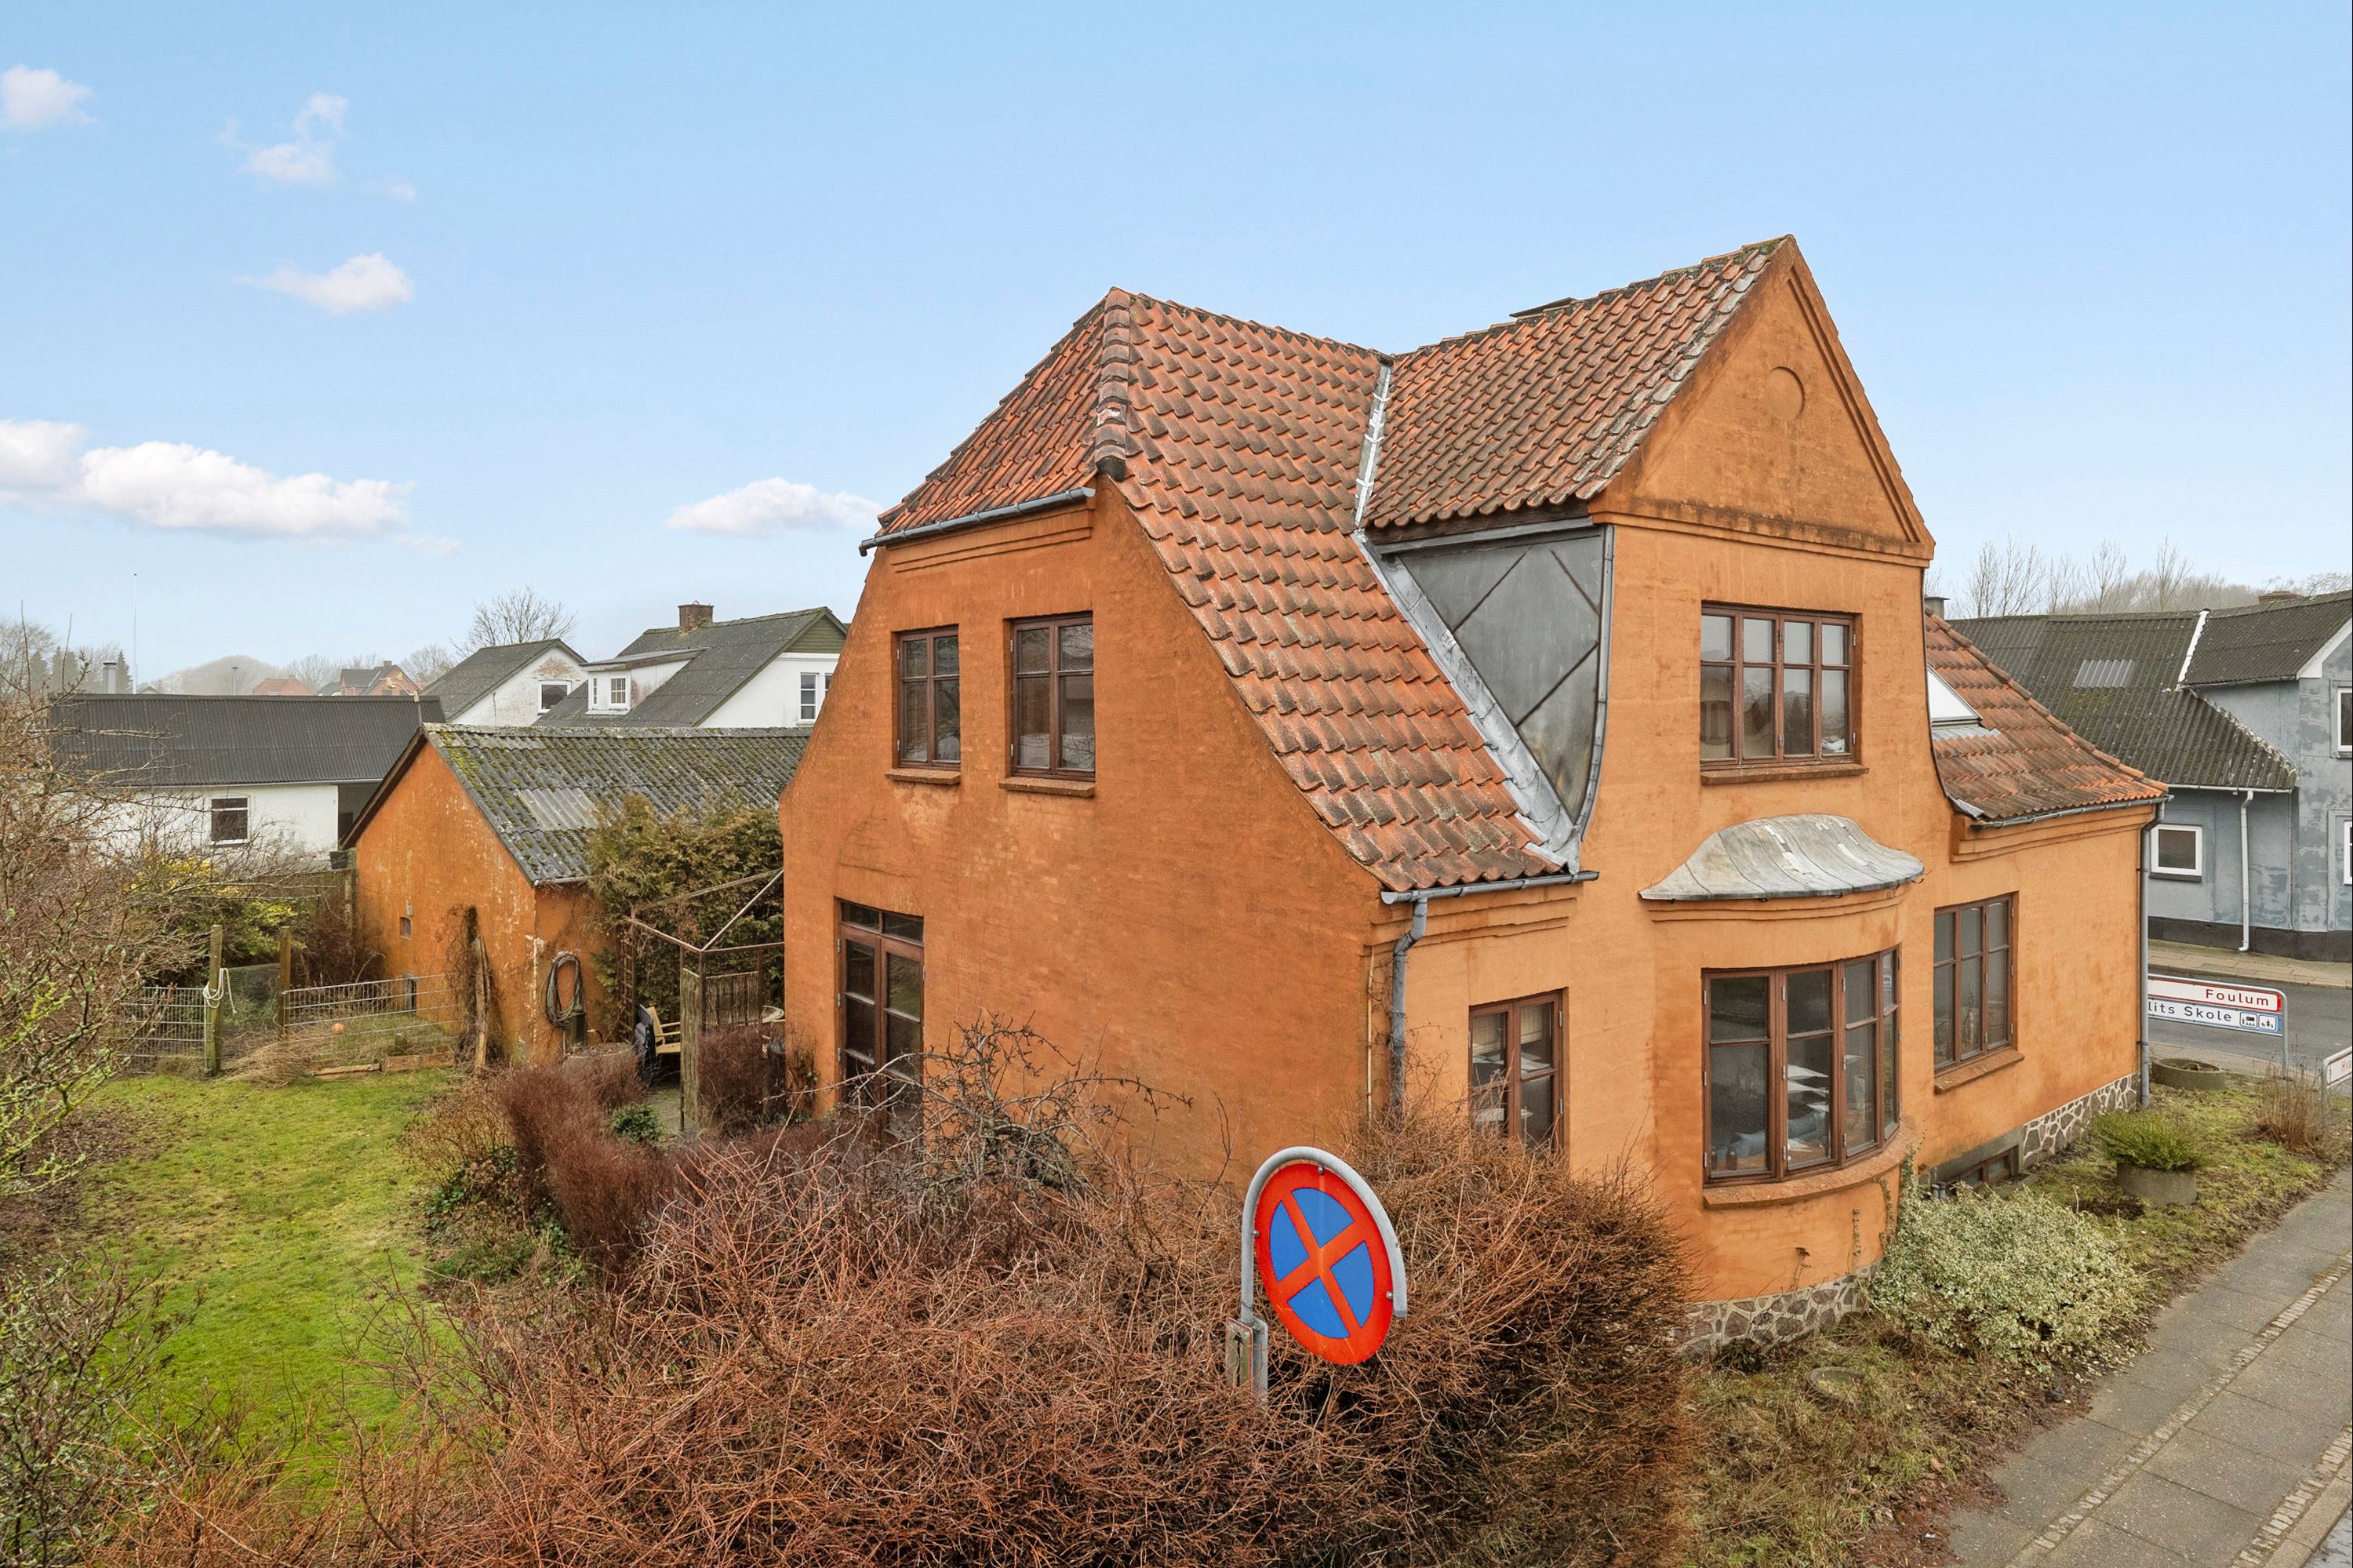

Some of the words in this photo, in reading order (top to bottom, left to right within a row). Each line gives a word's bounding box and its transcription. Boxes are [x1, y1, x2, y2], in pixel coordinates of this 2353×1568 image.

[2206, 988, 2269, 1006] Foulum
[2148, 1002, 2175, 1014] lits
[2184, 1006, 2232, 1021] Skole
